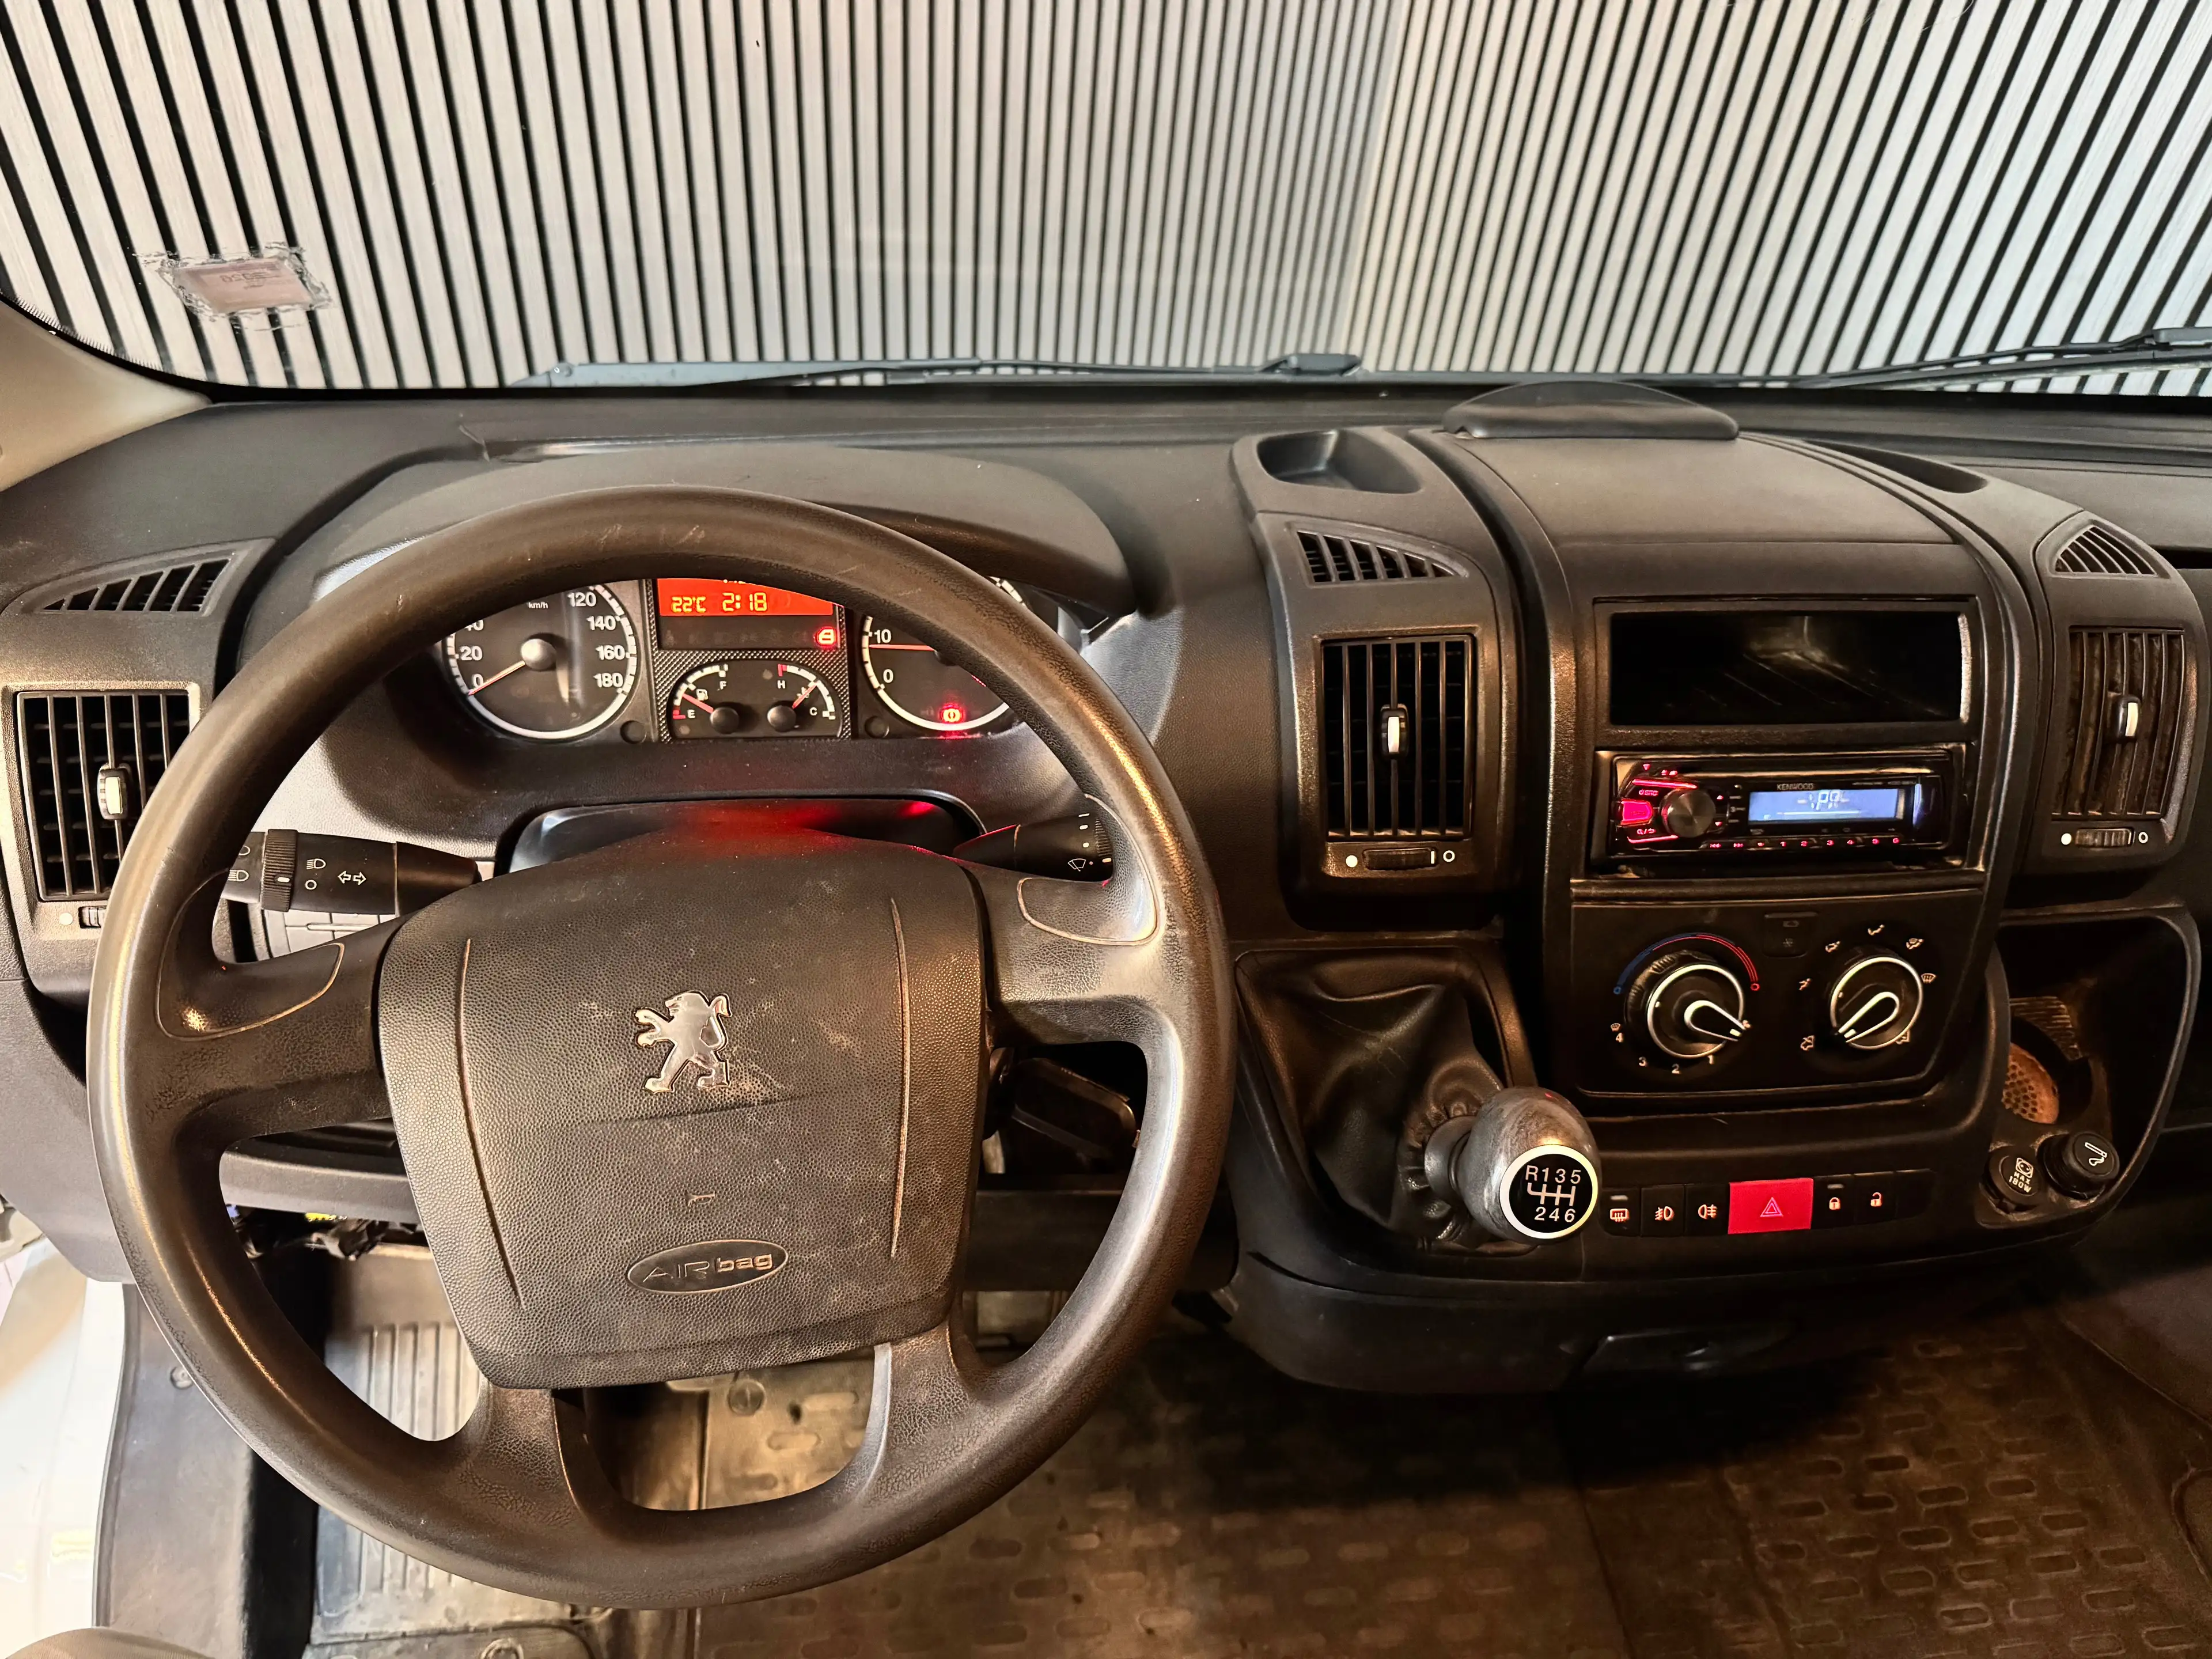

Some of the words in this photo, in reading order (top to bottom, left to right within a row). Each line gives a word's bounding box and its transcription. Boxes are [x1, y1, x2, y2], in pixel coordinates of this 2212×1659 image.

[528, 601, 548, 609] km/h
[568, 592, 597, 607] 120
[722, 592, 768, 612] 2:18
[586, 615, 616, 631] 140
[874, 628, 892, 643] 10
[459, 645, 483, 661] 20
[596, 645, 625, 660] 160
[471, 673, 484, 688] 0
[593, 673, 624, 688] 180
[882, 669, 894, 683] 0
[719, 680, 727, 690] F
[778, 680, 786, 689] H
[687, 709, 696, 719] E
[809, 707, 817, 716] C
[1777, 783, 1815, 791] KENWOOD
[1615, 1032, 1623, 1043] 4
[1638, 1056, 1647, 1066] 3
[1707, 1054, 1714, 1065] 1
[1672, 1063, 1680, 1074] 2
[2009, 1175, 2032, 1193] 180W
[2013, 1171, 2031, 1185] MAX
